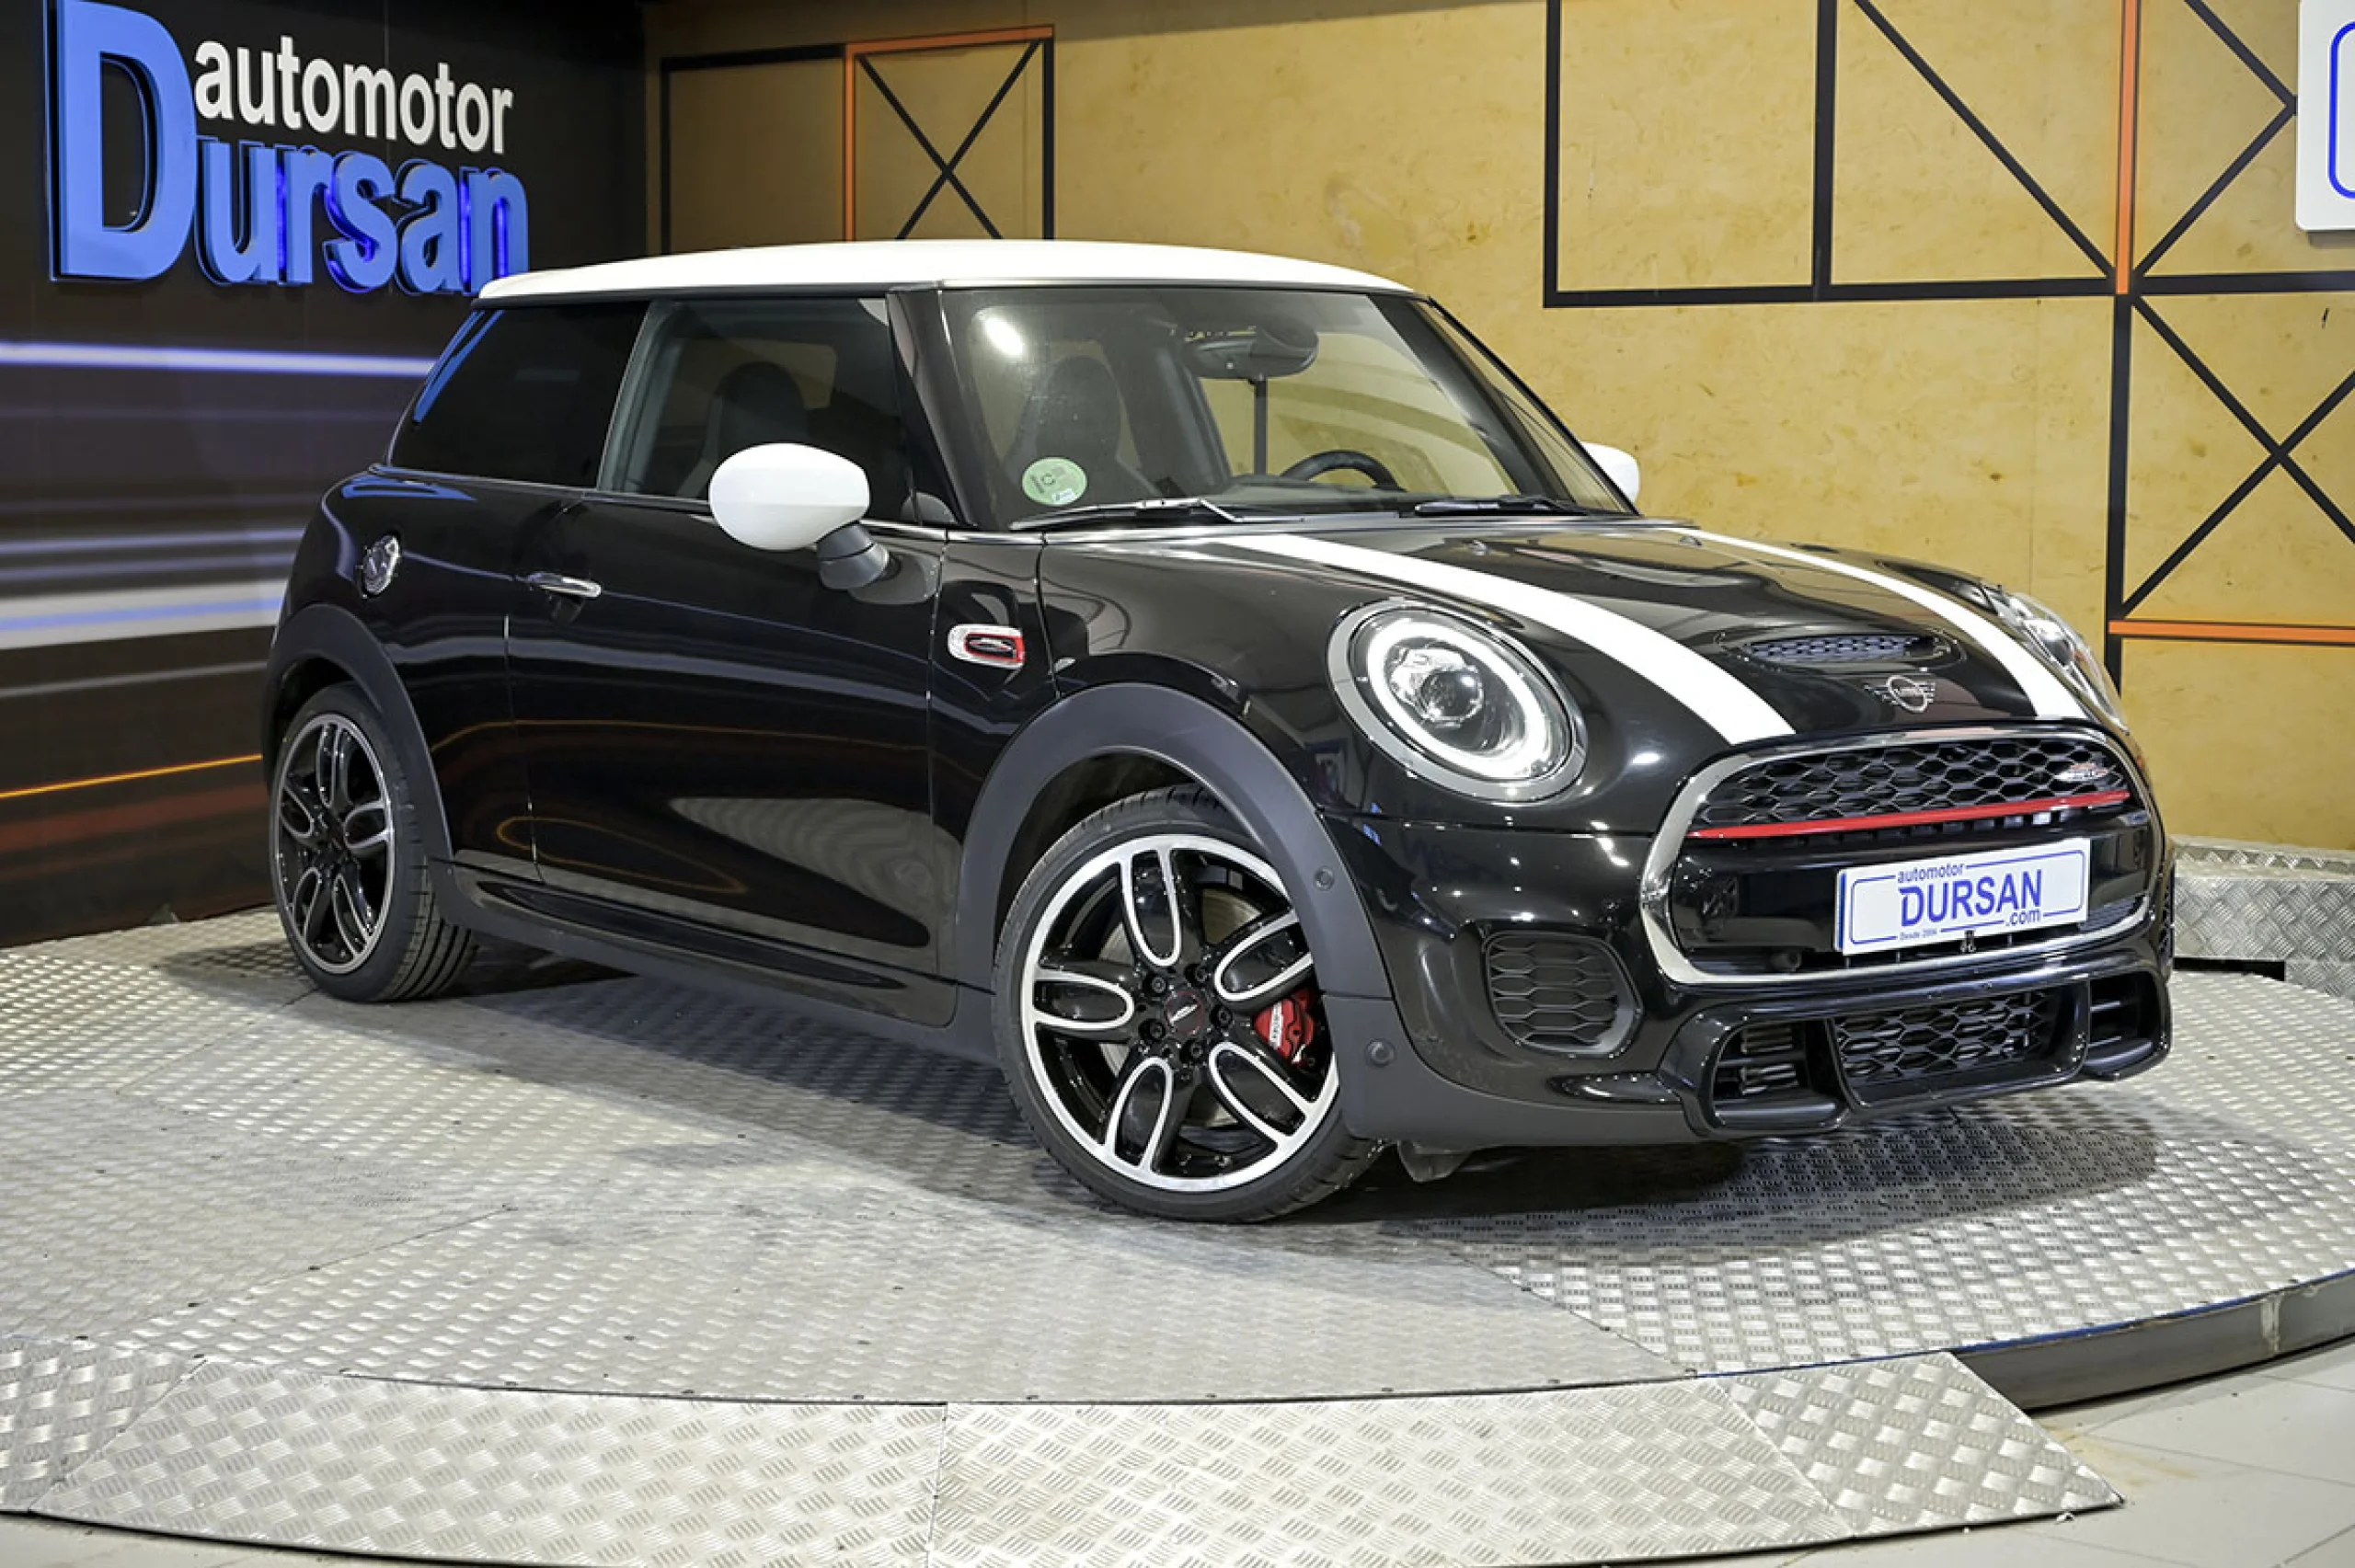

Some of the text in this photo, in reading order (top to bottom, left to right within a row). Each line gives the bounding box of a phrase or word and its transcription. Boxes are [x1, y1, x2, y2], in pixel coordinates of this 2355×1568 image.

[194, 35, 513, 155] automotor
[44, 0, 529, 295] Dursan
[1897, 863, 1965, 884] automotor
[1899, 868, 2042, 927] DURSAN
[2005, 908, 2041, 927] .com
